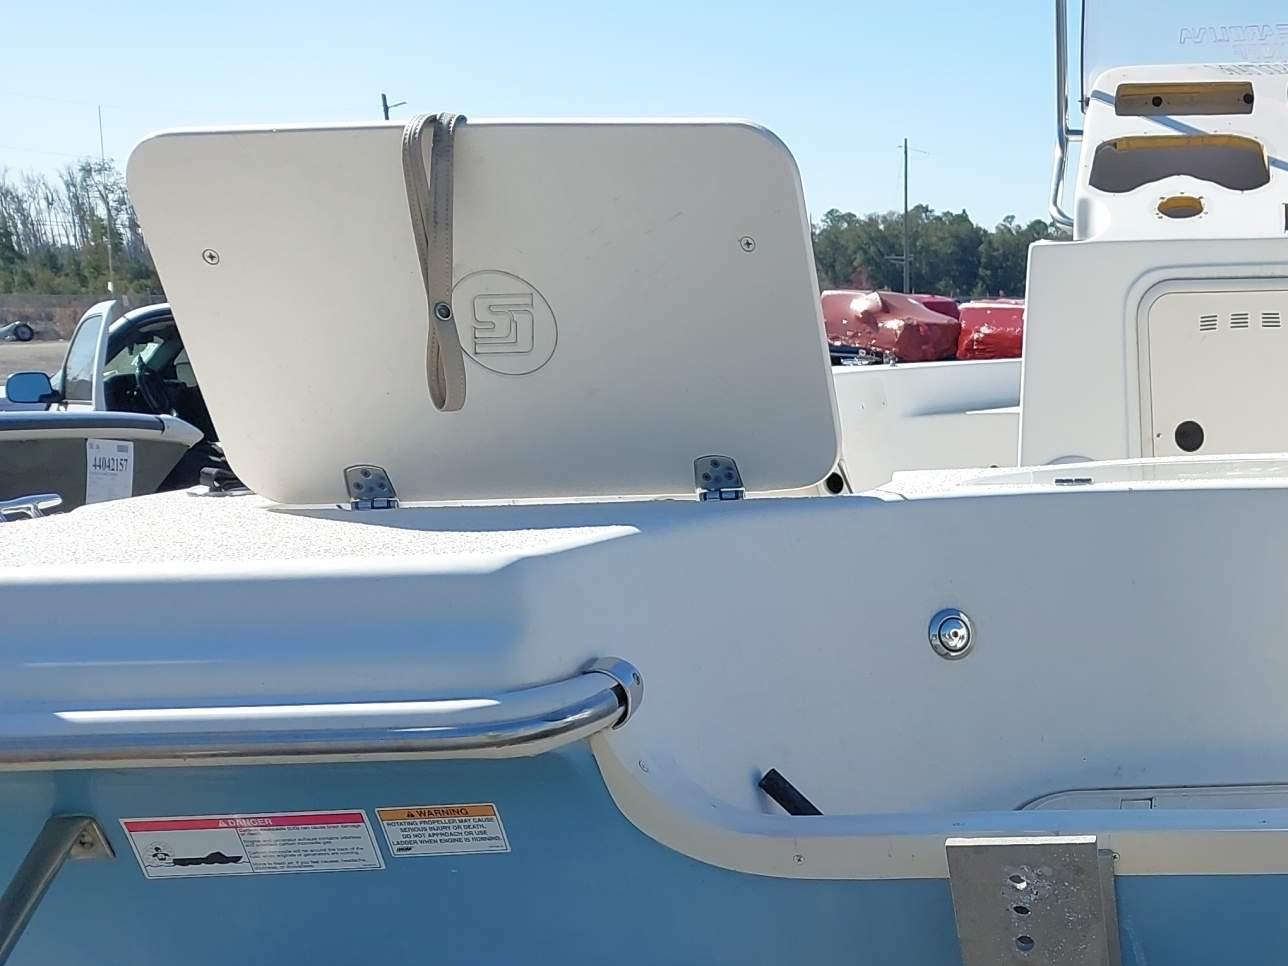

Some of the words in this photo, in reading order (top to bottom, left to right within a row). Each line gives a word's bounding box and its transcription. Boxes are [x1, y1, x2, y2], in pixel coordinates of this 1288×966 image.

[92, 456, 129, 472] 44042157
[416, 808, 469, 817] WARNING
[228, 818, 273, 827] DANGER
[387, 820, 419, 828] ROTATING
[419, 818, 459, 826] PROPELLER
